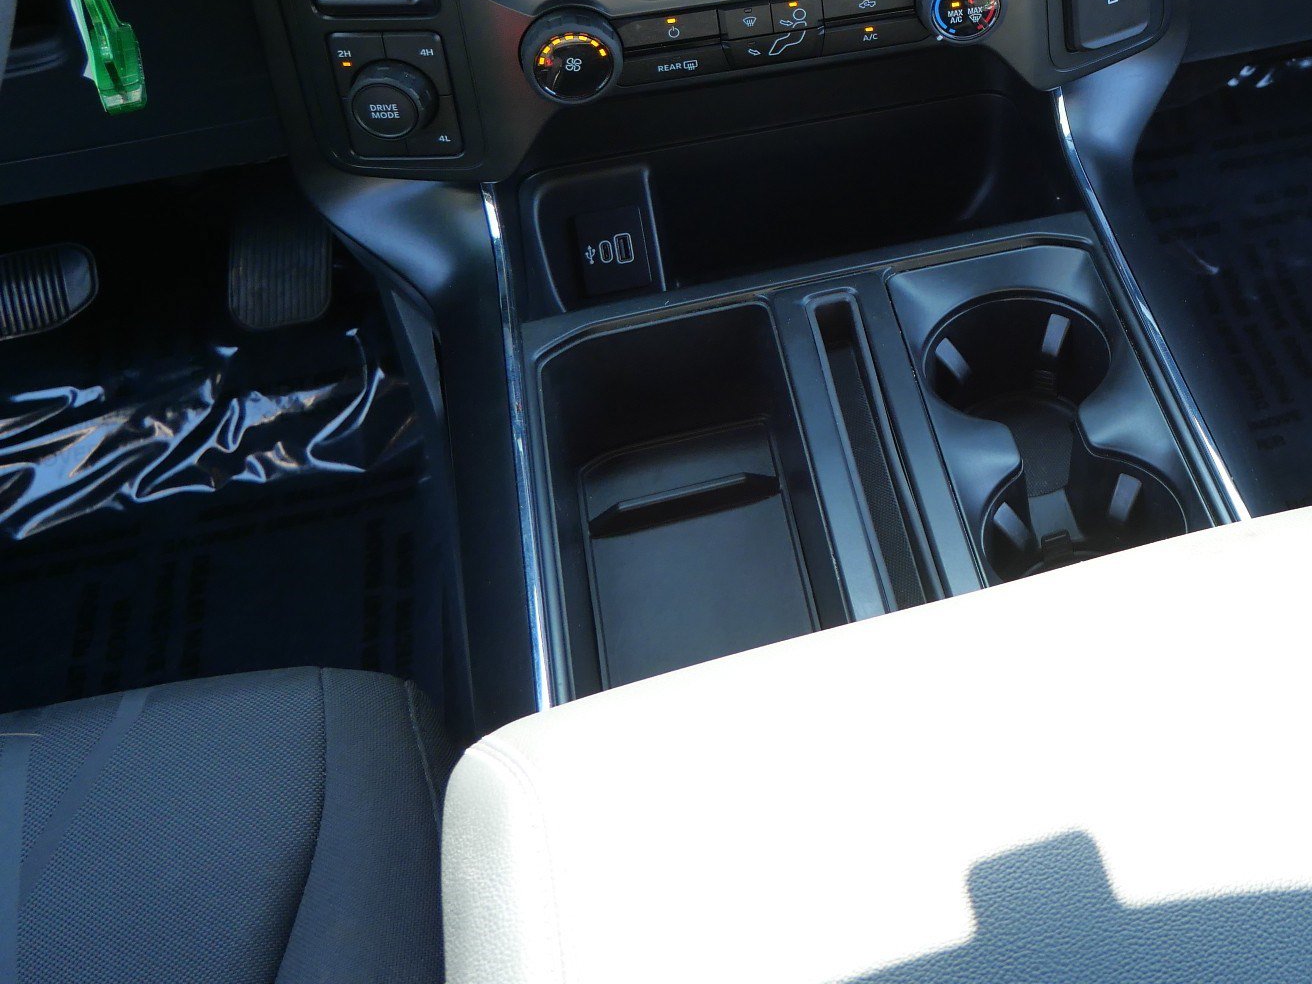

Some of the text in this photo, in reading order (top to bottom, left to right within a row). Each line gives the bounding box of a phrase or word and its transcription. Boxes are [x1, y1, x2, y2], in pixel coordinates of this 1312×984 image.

[947, 9, 964, 18] MAX
[967, 6, 984, 15] MAX
[949, 16, 963, 24] A/C
[862, 33, 879, 42] A/C
[337, 50, 352, 58] 2H
[419, 48, 434, 56] 4H
[657, 62, 683, 73] REAR
[369, 103, 398, 112] DRIVE
[371, 111, 401, 119] MODE
